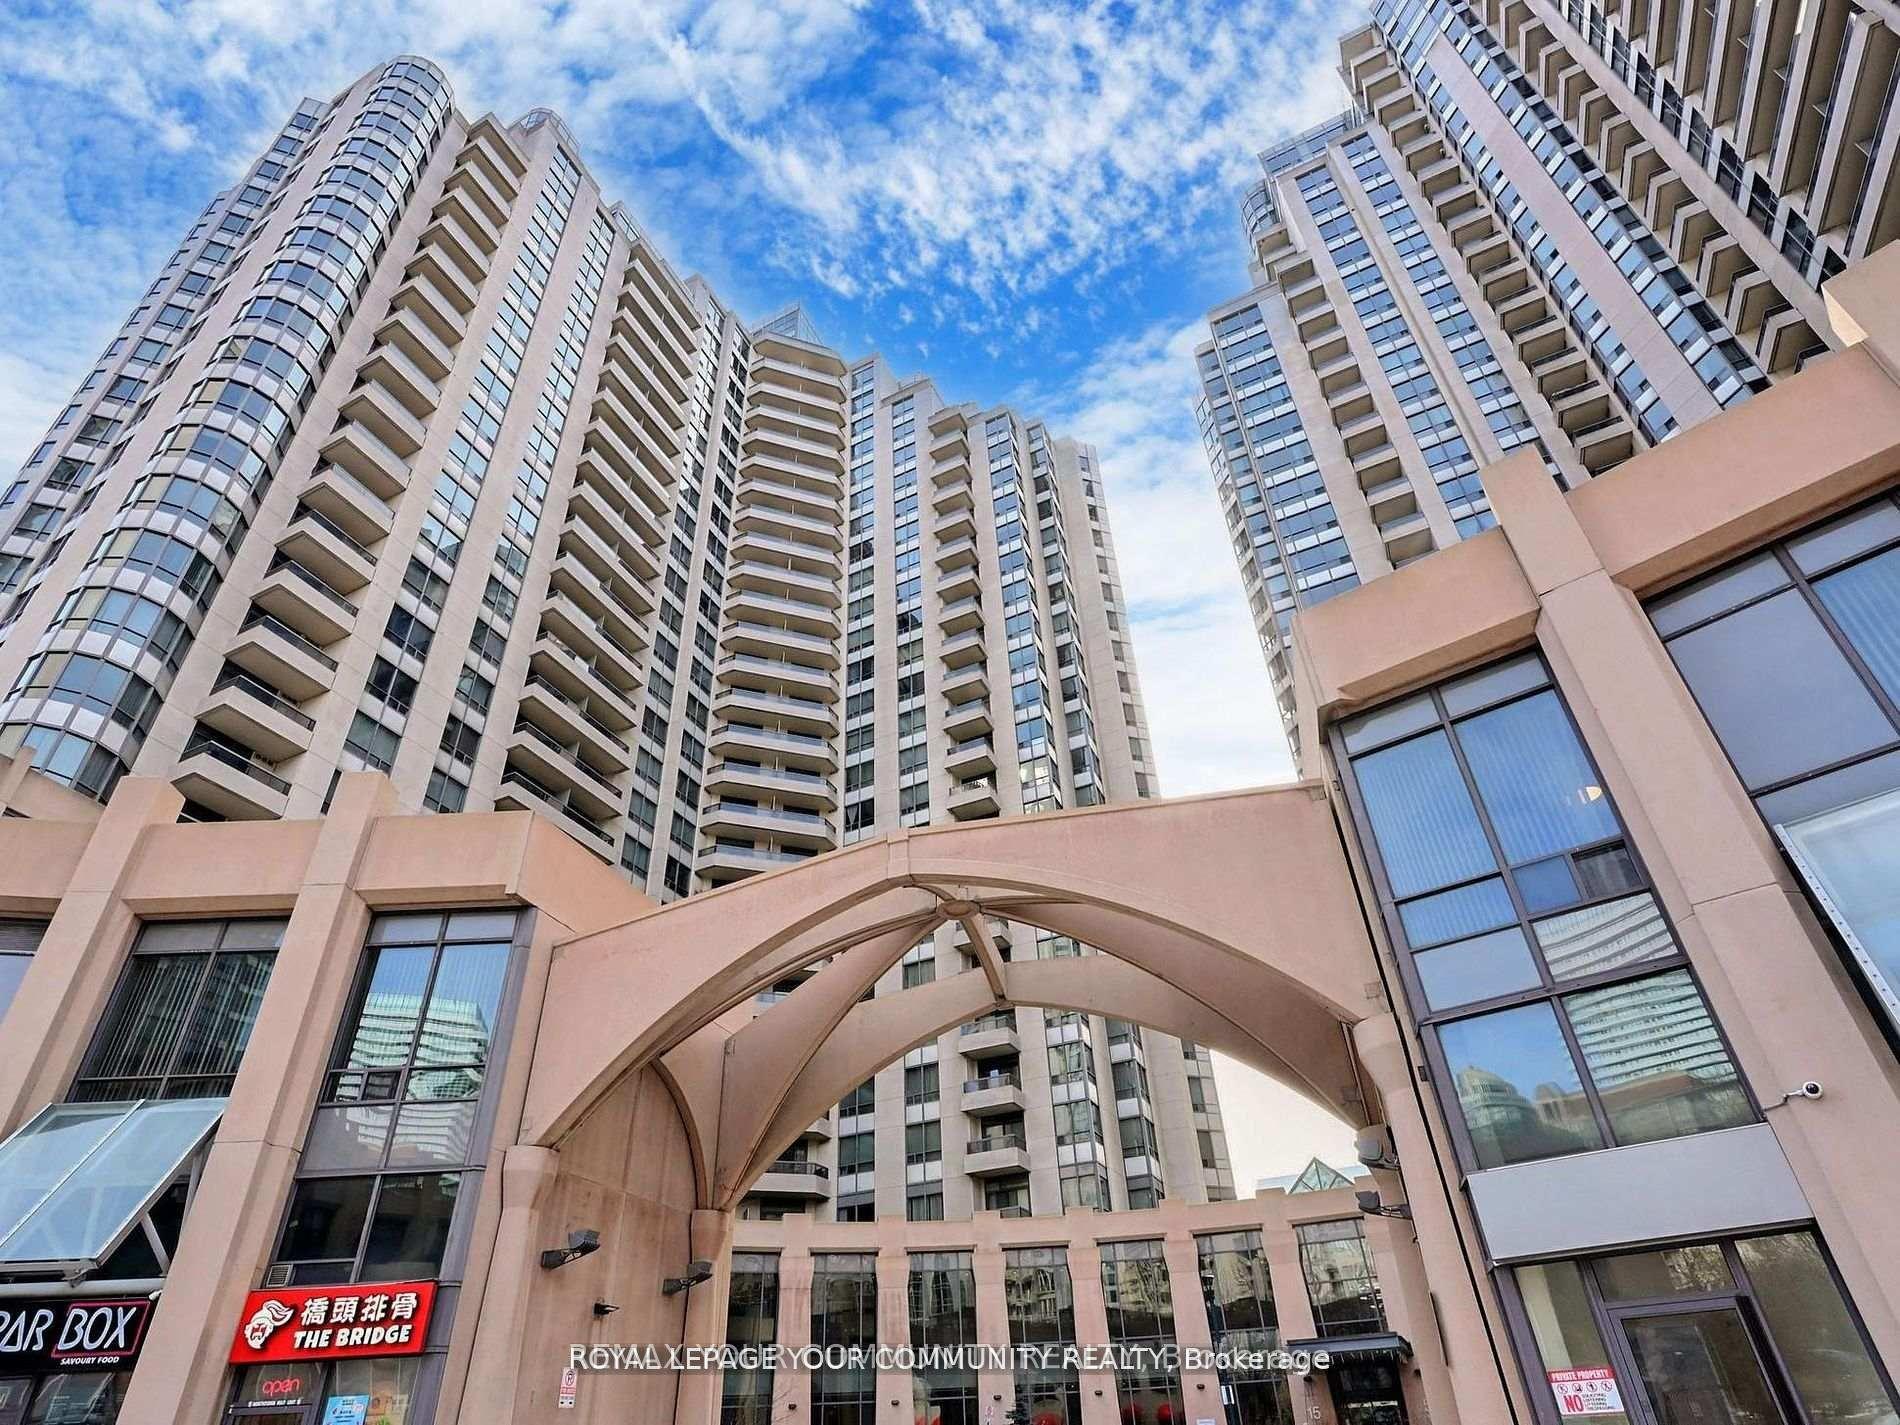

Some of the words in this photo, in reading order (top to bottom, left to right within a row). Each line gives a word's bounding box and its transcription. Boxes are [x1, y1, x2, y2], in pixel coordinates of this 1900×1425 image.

[300, 1292, 417, 1326] 橋頭排骨
[57, 1307, 137, 1350] BOX
[294, 1329, 333, 1349] THE
[335, 1324, 412, 1347] BRIDGE
[60, 1357, 96, 1365] SAVOURY
[1306, 1406, 1321, 1420] 15
[1563, 1394, 1584, 1412] NO
